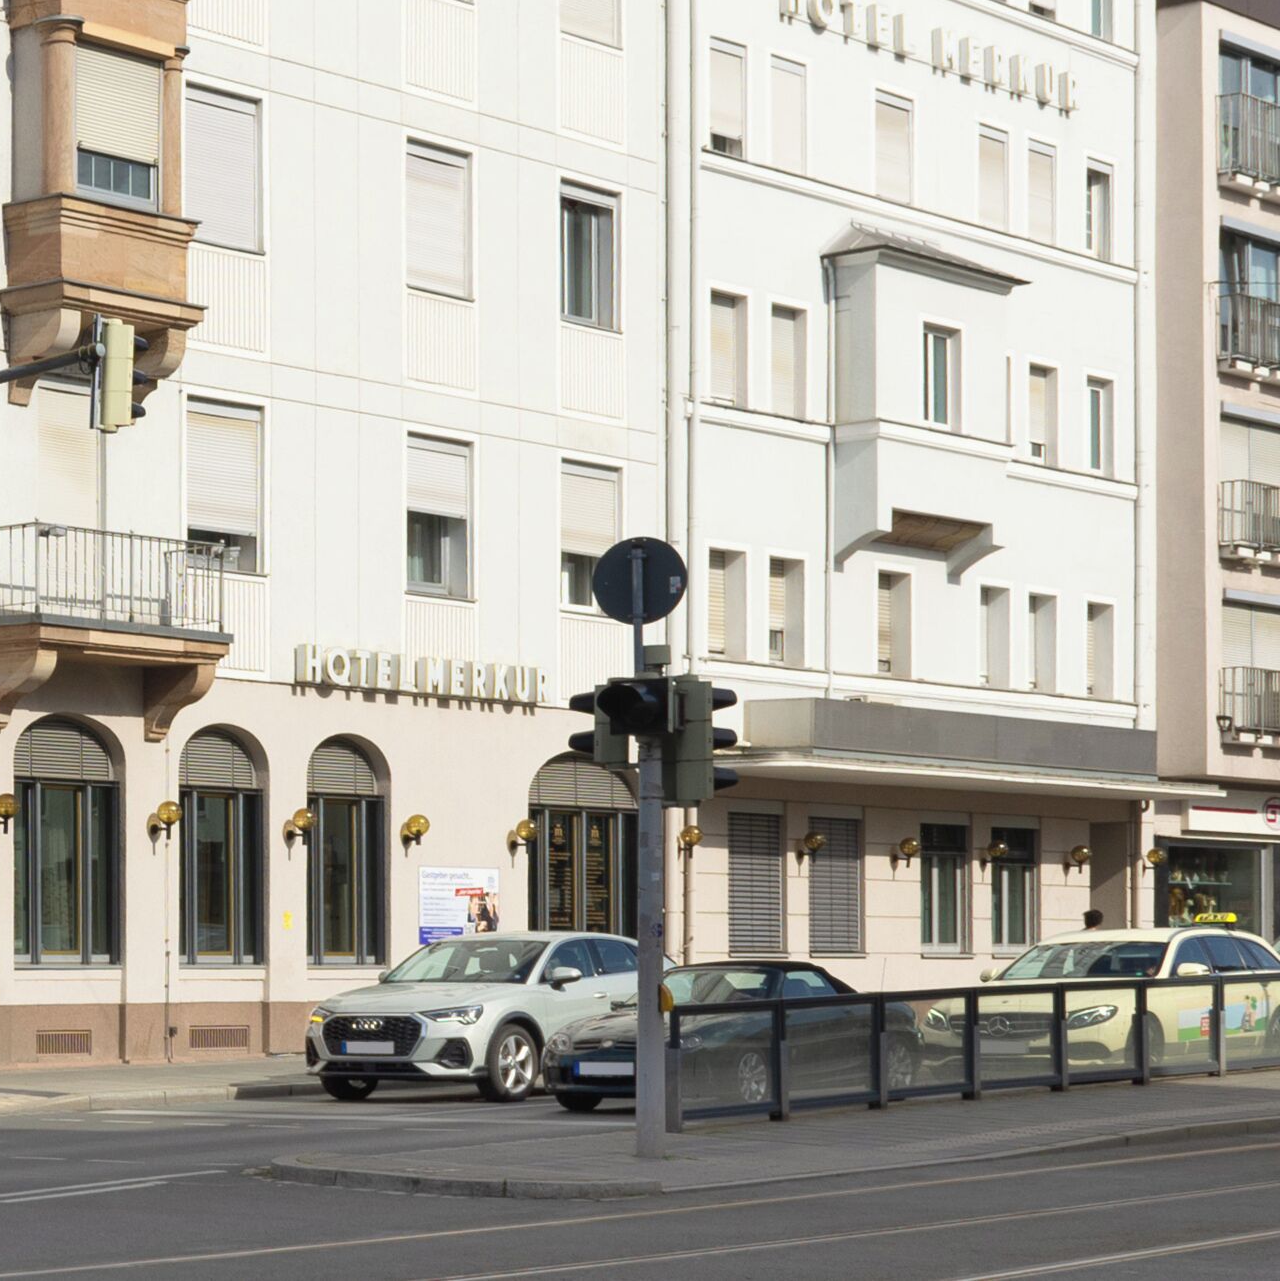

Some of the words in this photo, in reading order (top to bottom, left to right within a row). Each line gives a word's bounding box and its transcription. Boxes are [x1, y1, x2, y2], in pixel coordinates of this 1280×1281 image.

[930, 27, 1080, 111] MERKUR
[295, 643, 417, 693] HOTEL
[419, 656, 552, 704] MERKUR
